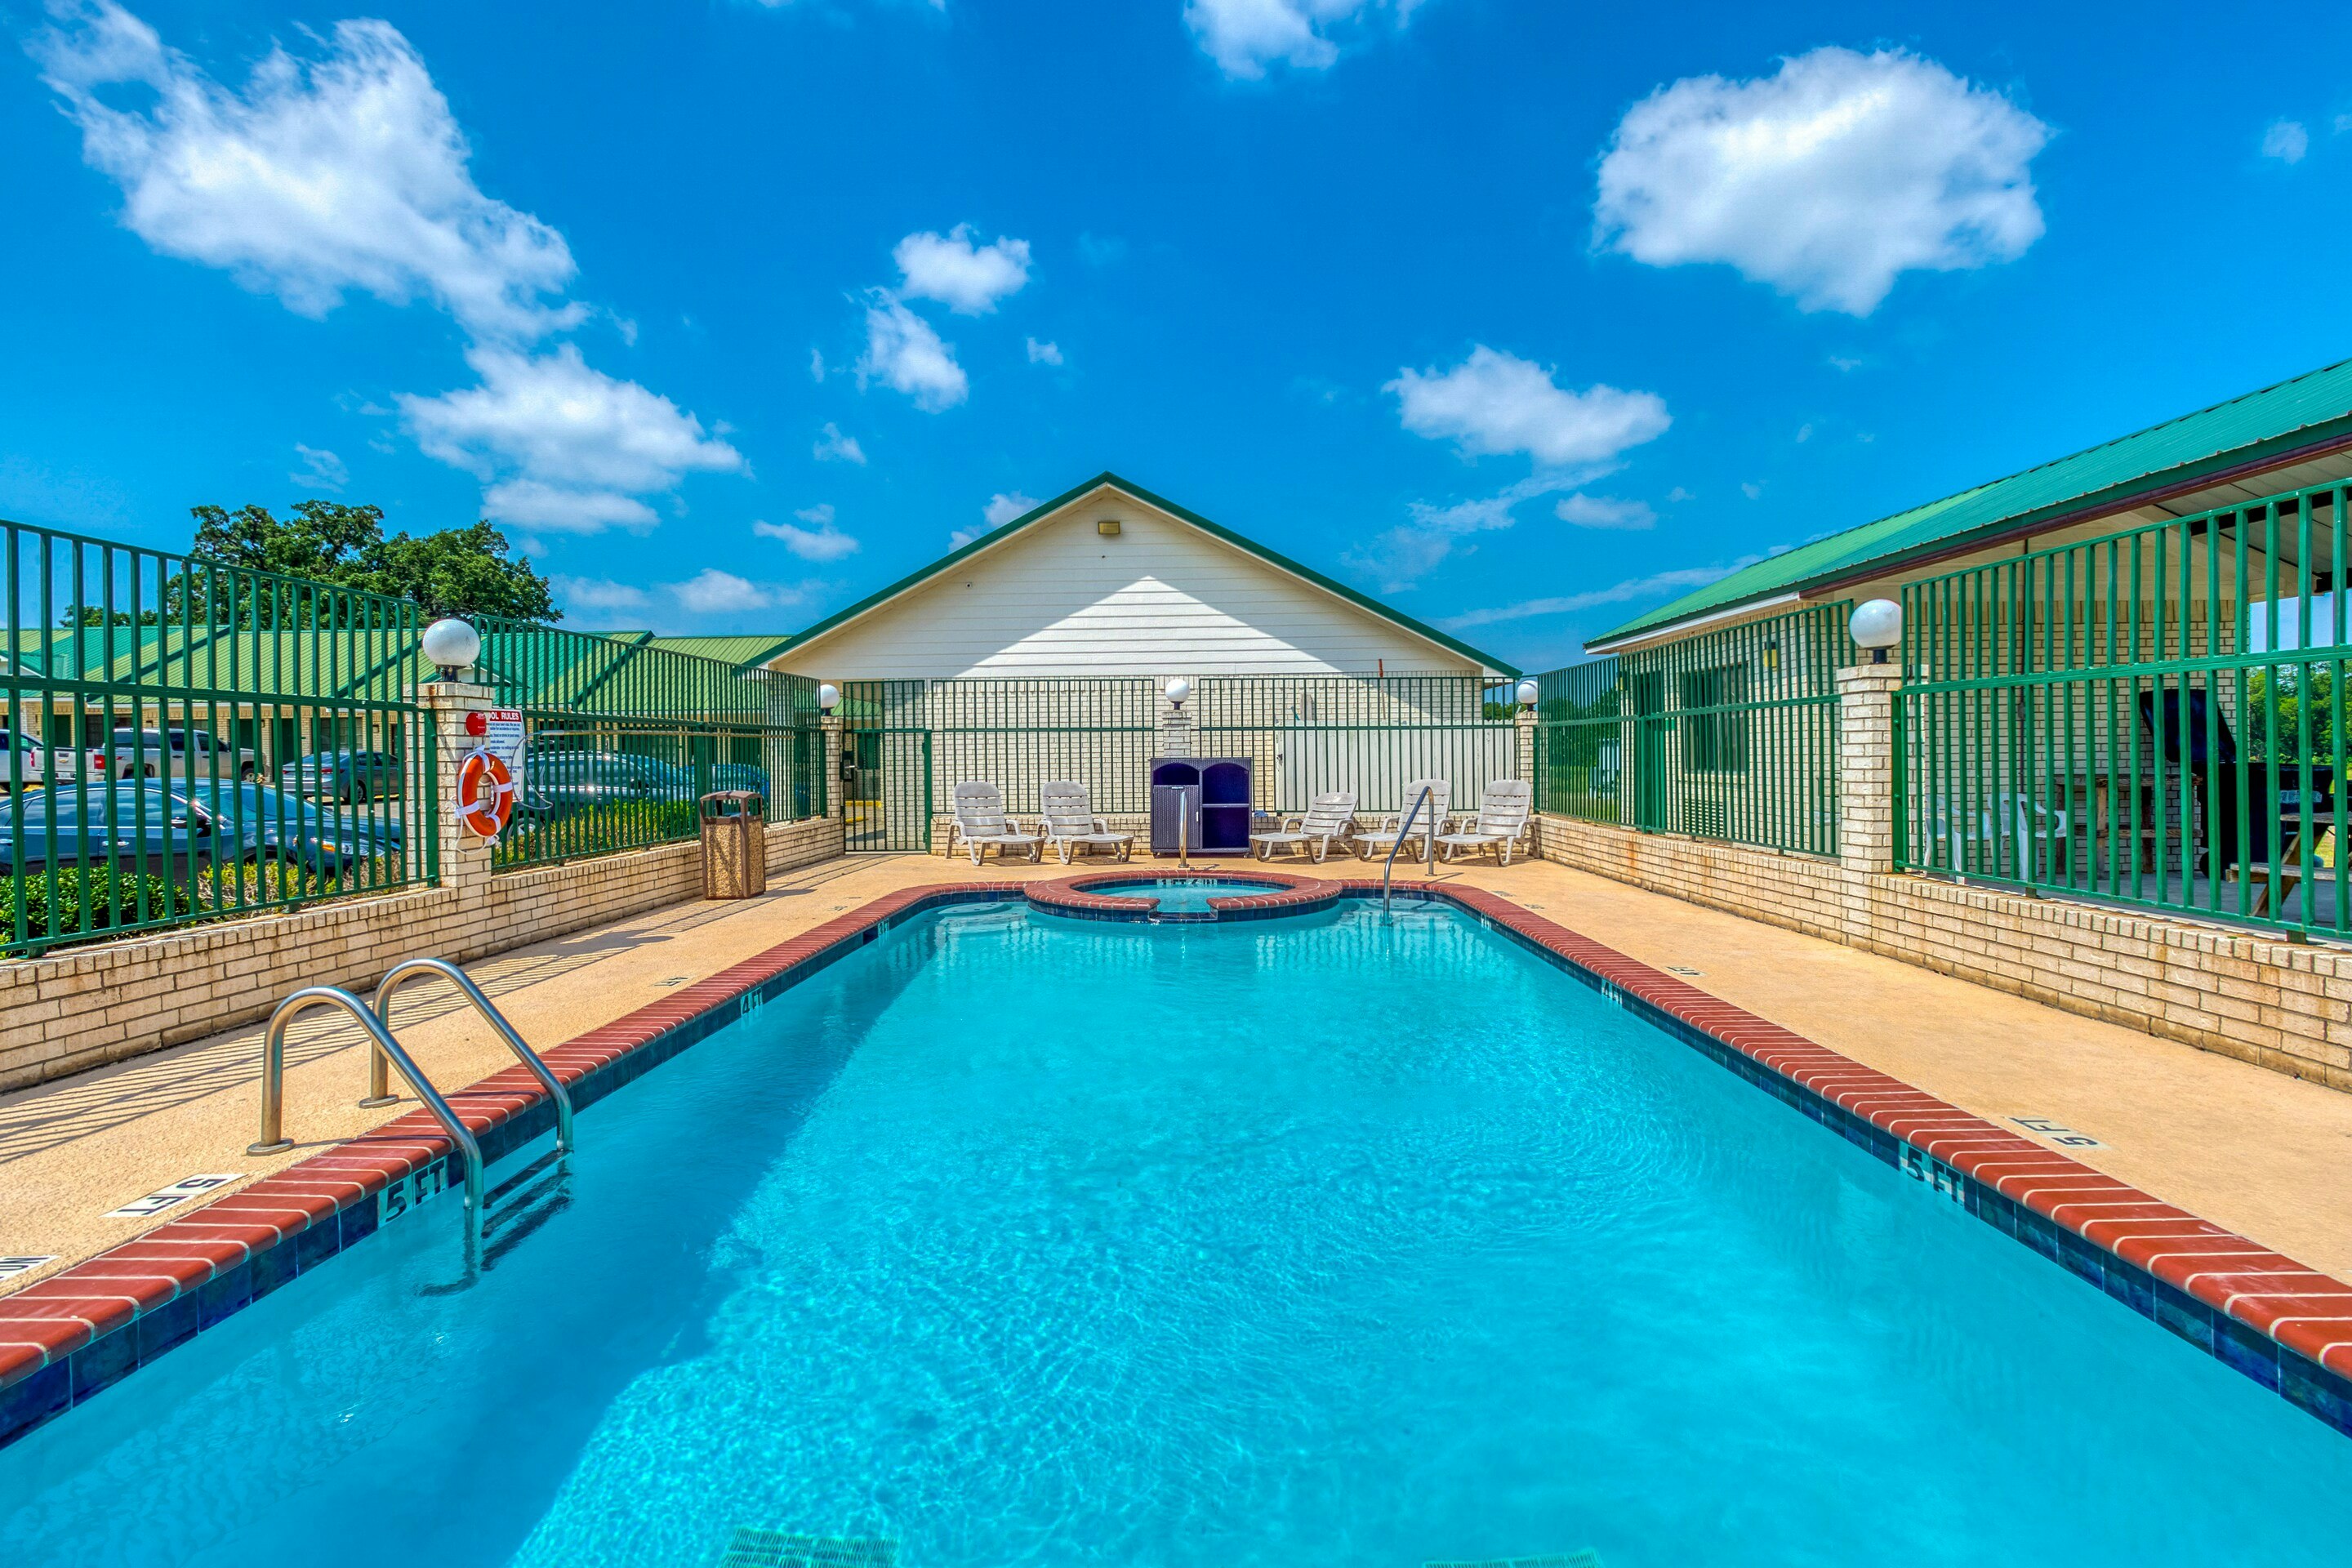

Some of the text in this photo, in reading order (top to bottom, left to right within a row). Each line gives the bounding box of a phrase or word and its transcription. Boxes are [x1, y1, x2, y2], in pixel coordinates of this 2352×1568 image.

[501, 711, 519, 720] RULES
[742, 988, 762, 1014] 4 FT
[2009, 1117, 2099, 1146] 5 FT
[385, 1158, 445, 1223] 5 FT
[1907, 1146, 1962, 1203] 5 FT
[117, 1178, 229, 1216] 5 FT
